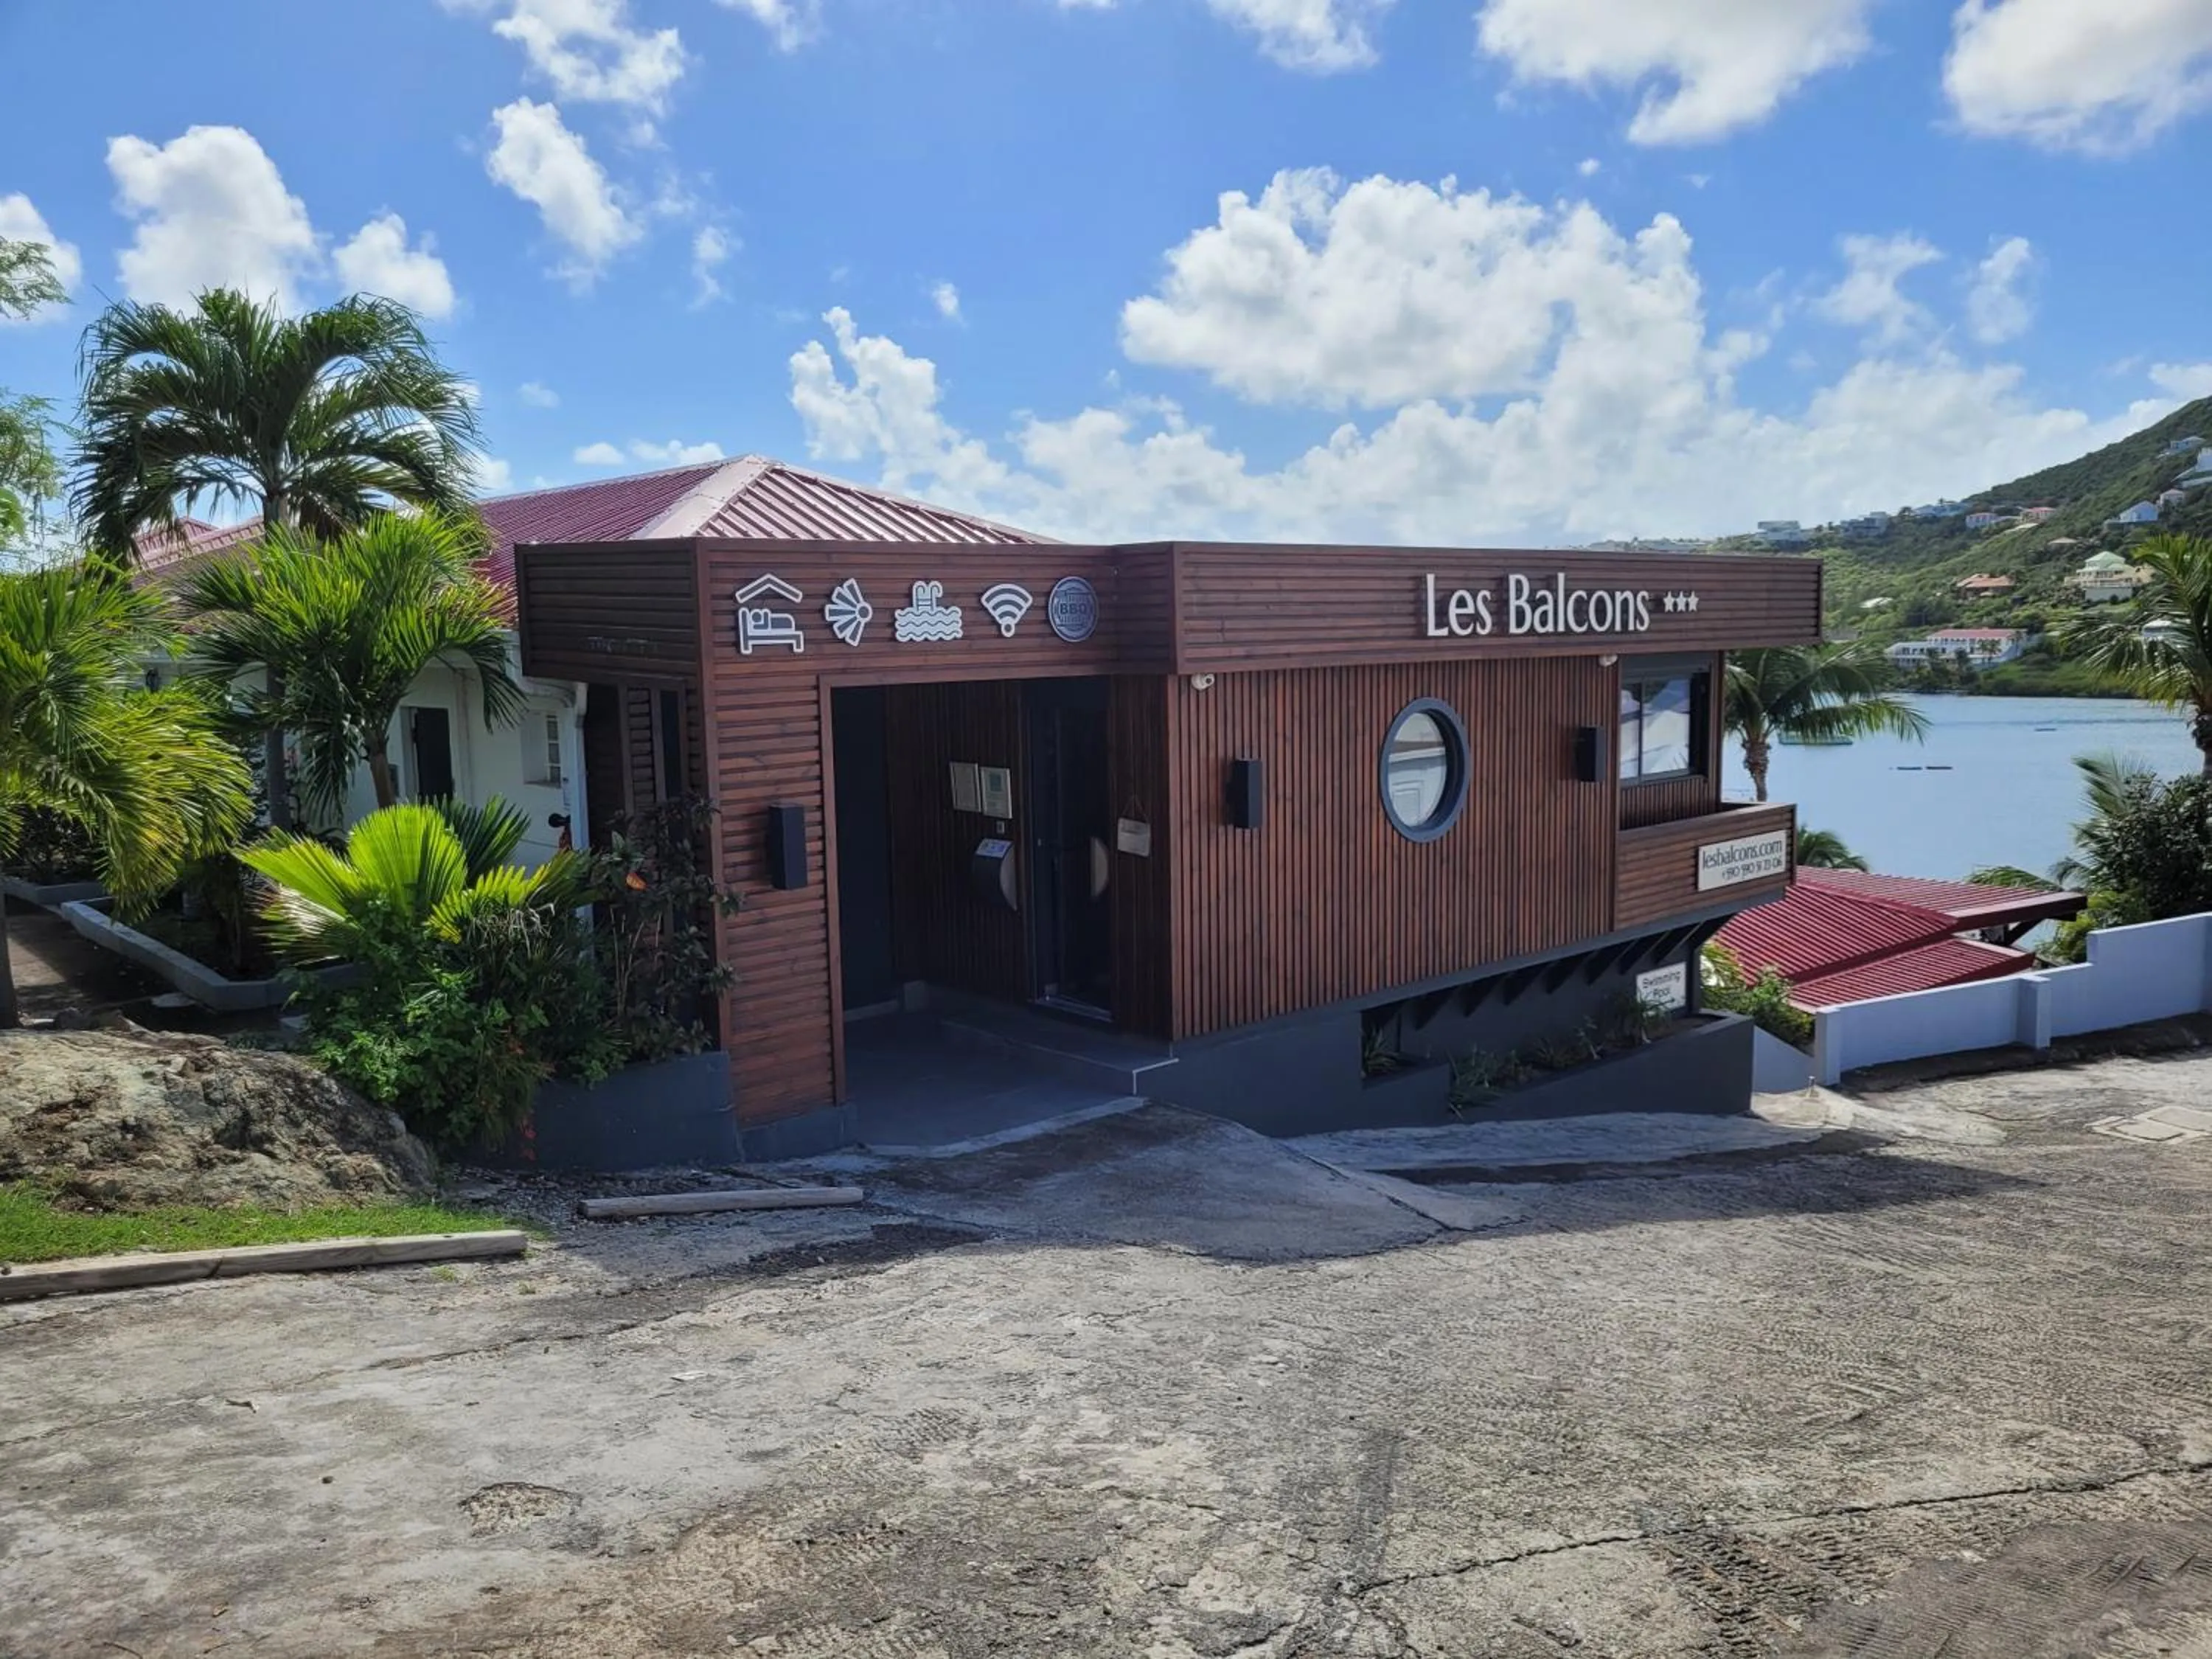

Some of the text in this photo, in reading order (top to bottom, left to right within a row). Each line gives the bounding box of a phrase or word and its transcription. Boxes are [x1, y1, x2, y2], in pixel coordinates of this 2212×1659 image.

[1060, 602, 1088, 614] BBQ
[1427, 572, 1650, 636] Les Balcons
[1703, 840, 1782, 870] lesbalcons.com
[1643, 970, 1680, 989] Swimming
